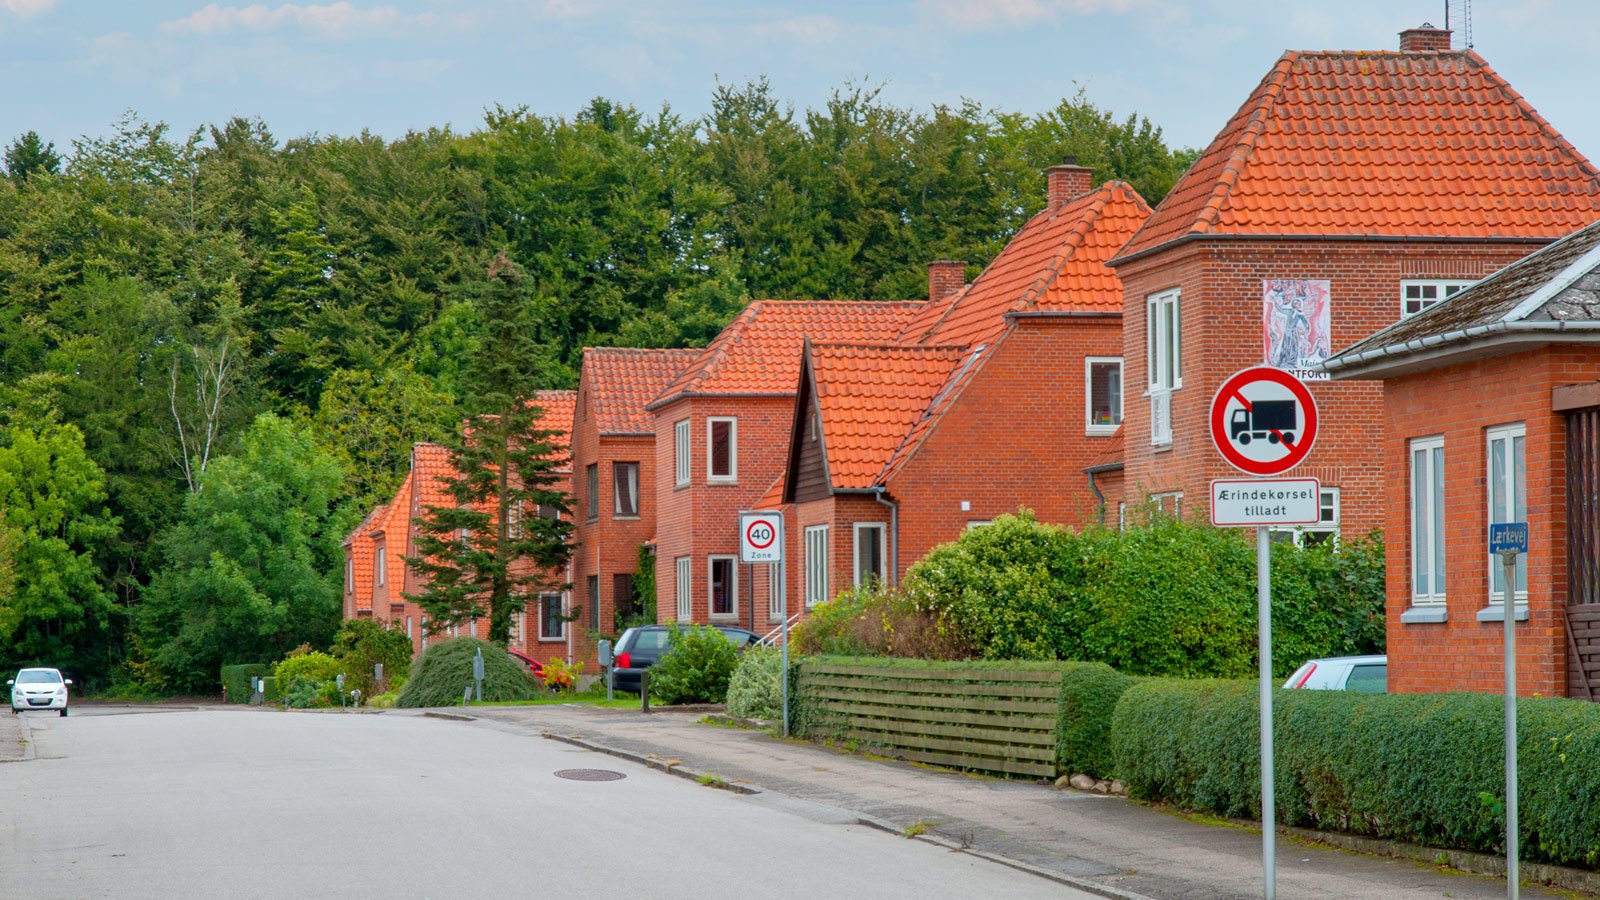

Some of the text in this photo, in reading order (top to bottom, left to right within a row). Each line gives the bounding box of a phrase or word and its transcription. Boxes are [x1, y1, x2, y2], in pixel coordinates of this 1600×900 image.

[1218, 489, 1314, 500] Ærindekørsel
[1245, 505, 1287, 516] tilladt
[751, 528, 770, 540] 40
[1491, 526, 1526, 549] Lærkevej
